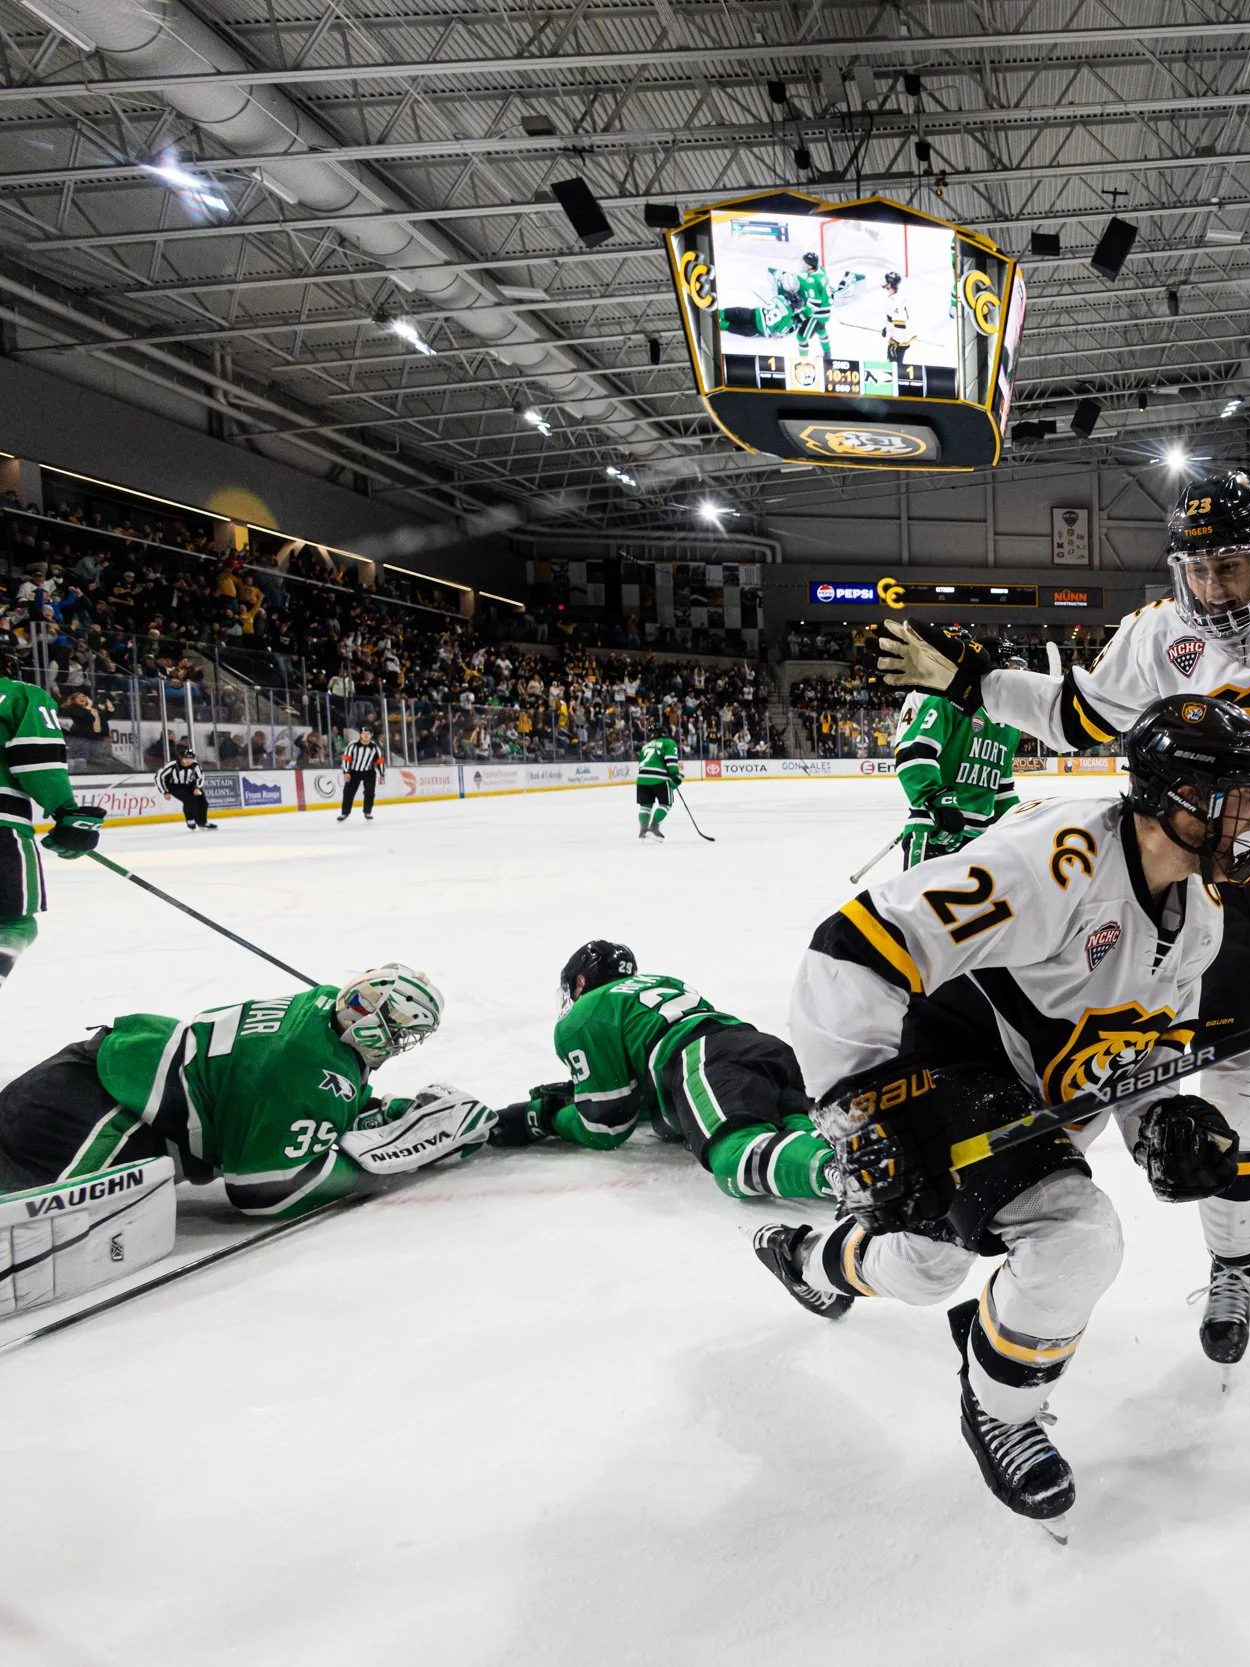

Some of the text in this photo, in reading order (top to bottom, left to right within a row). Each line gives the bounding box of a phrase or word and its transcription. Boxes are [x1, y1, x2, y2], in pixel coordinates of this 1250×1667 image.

[767, 356, 776, 371] 1
[906, 365, 915, 380] 1
[827, 369, 860, 383] 10:10
[1187, 497, 1212, 516] 23
[1184, 525, 1213, 537] TIGERS
[836, 588, 874, 599] PEPSI
[1168, 640, 1204, 660] NCHC
[920, 709, 938, 729] 9
[969, 737, 1008, 766] NORT
[1174, 750, 1216, 763] BAUER
[725, 764, 767, 773] TOYOTA
[878, 763, 897, 773] En
[1013, 758, 1047, 768] ADLEY
[956, 763, 1000, 790] DAKO
[97, 793, 156, 817] Phipps
[1167, 791, 1197, 812] BAUER
[922, 865, 1014, 945] 21
[1086, 928, 1121, 947] NCHC
[619, 960, 633, 975] 29
[1115, 1046, 1215, 1098] BAUER
[849, 1068, 937, 1122] BAU
[284, 1119, 339, 1158] 35
[370, 1130, 453, 1162] VAUGHN
[25, 1168, 144, 1218] VAUGHN
